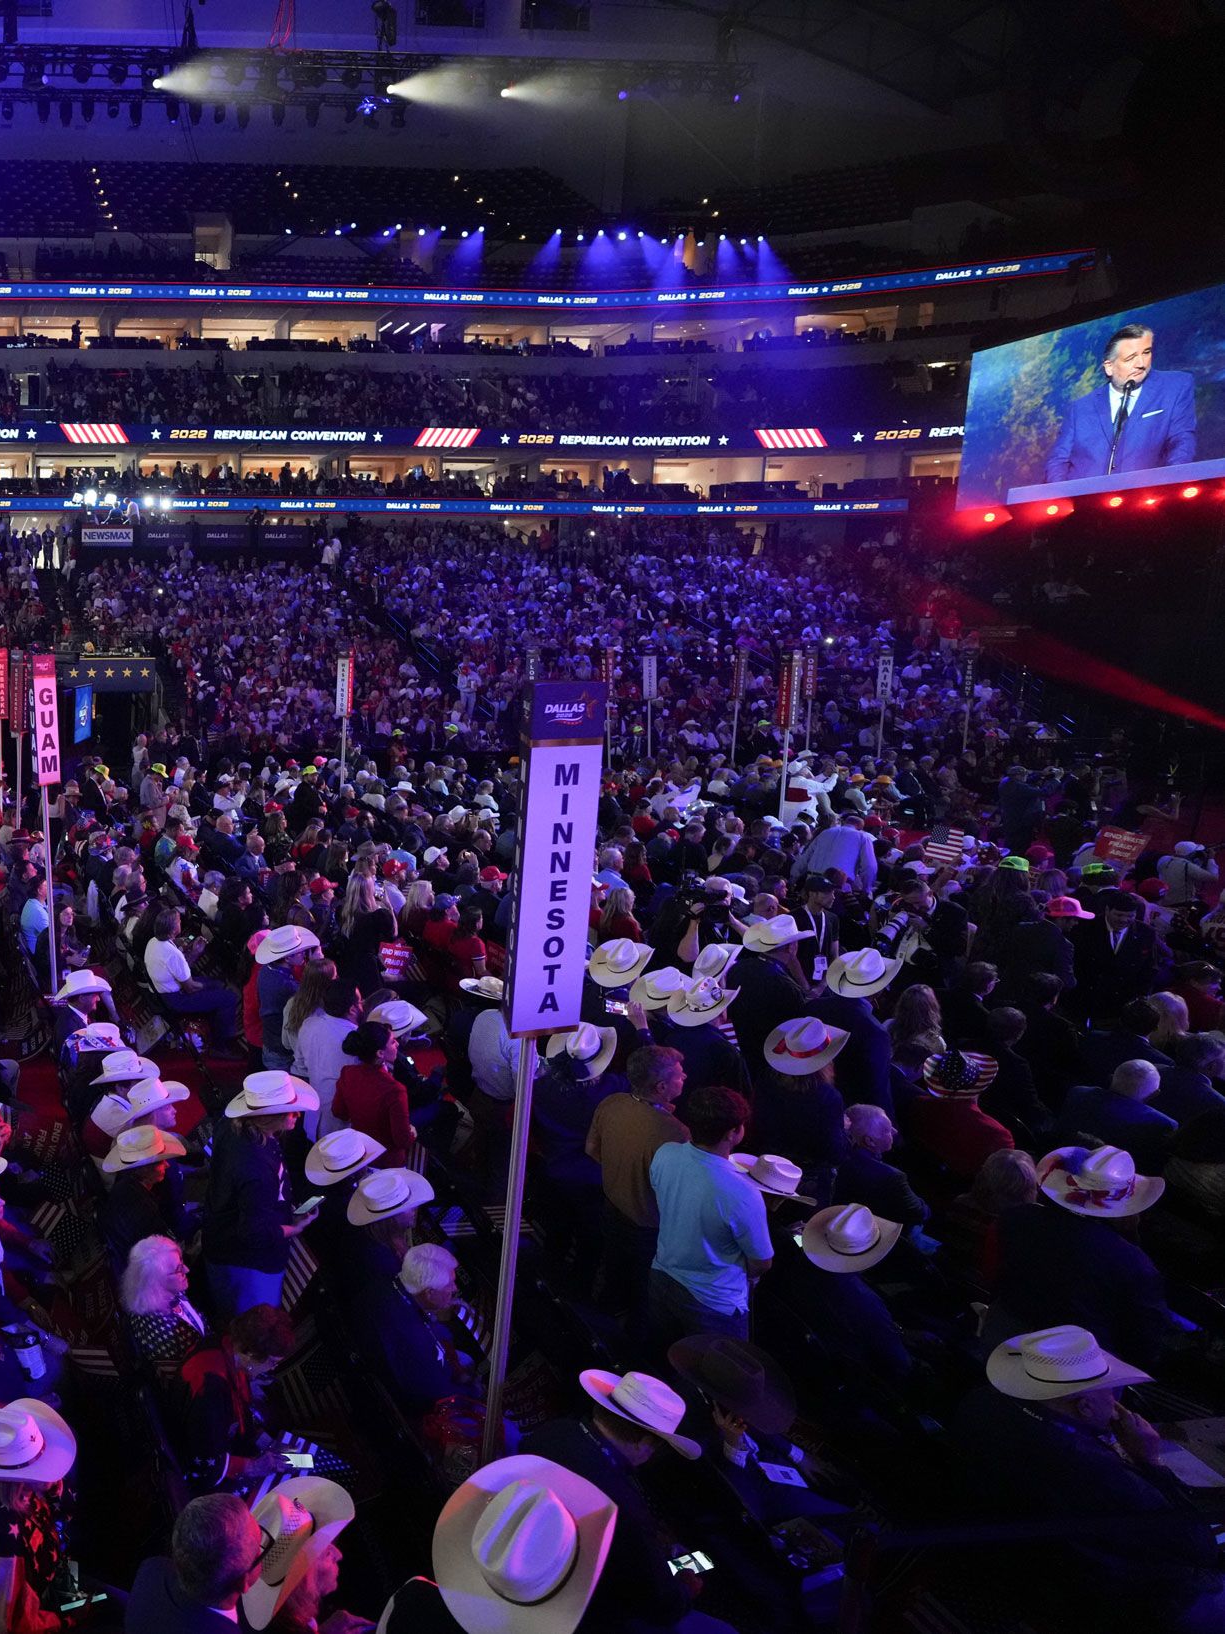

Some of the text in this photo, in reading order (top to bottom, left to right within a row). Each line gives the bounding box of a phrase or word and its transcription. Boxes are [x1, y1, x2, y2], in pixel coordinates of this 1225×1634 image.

[935, 270, 971, 280] DALLAS
[170, 430, 366, 441] 2026 REPUBLICAN CONVENTION
[875, 429, 921, 440] 2026
[518, 435, 710, 446] 2026 REPUBLICAN CONVENTION
[171, 500, 197, 509] DALLAS
[84, 531, 132, 540] NEWSMAX
[805, 658, 815, 696] OREGON
[879, 658, 891, 697] MAINE
[966, 659, 974, 697] VERMONT
[544, 703, 586, 715] DALLAS
[38, 688, 58, 773] GUAM
[537, 763, 580, 1016] MINNESOTA
